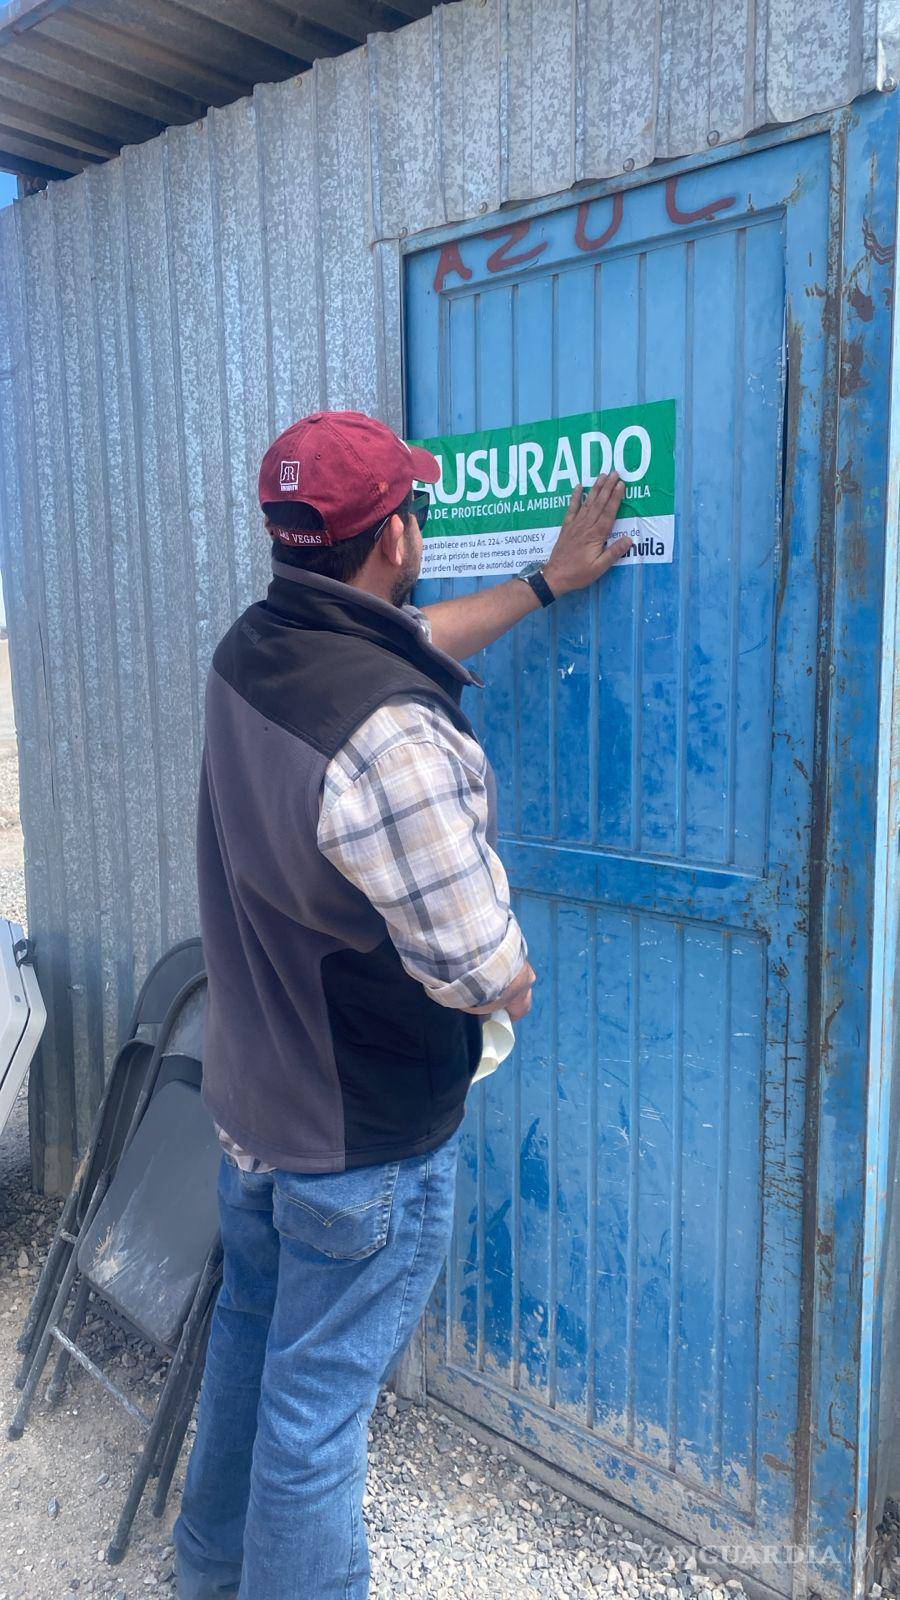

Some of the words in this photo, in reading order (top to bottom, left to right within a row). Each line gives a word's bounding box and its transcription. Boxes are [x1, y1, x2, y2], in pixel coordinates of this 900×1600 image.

[434, 508, 449, 520] DE
[451, 500, 511, 518] PROTECCIÓN
[512, 502, 525, 513] AL
[279, 528, 290, 541] LAS
[292, 533, 322, 544] VEGAS
[631, 527, 640, 537] de
[429, 540, 459, 550] establece
[460, 541, 468, 549] en
[469, 540, 476, 548] su
[504, 533, 540, 545] SANCIONES
[541, 532, 546, 541] Y
[620, 537, 665, 559] huila
[470, 551, 479, 559] de
[491, 549, 510, 557] meses
[517, 546, 528, 555] dos
[477, 562, 485, 570] de
[486, 560, 514, 570] autoridad
